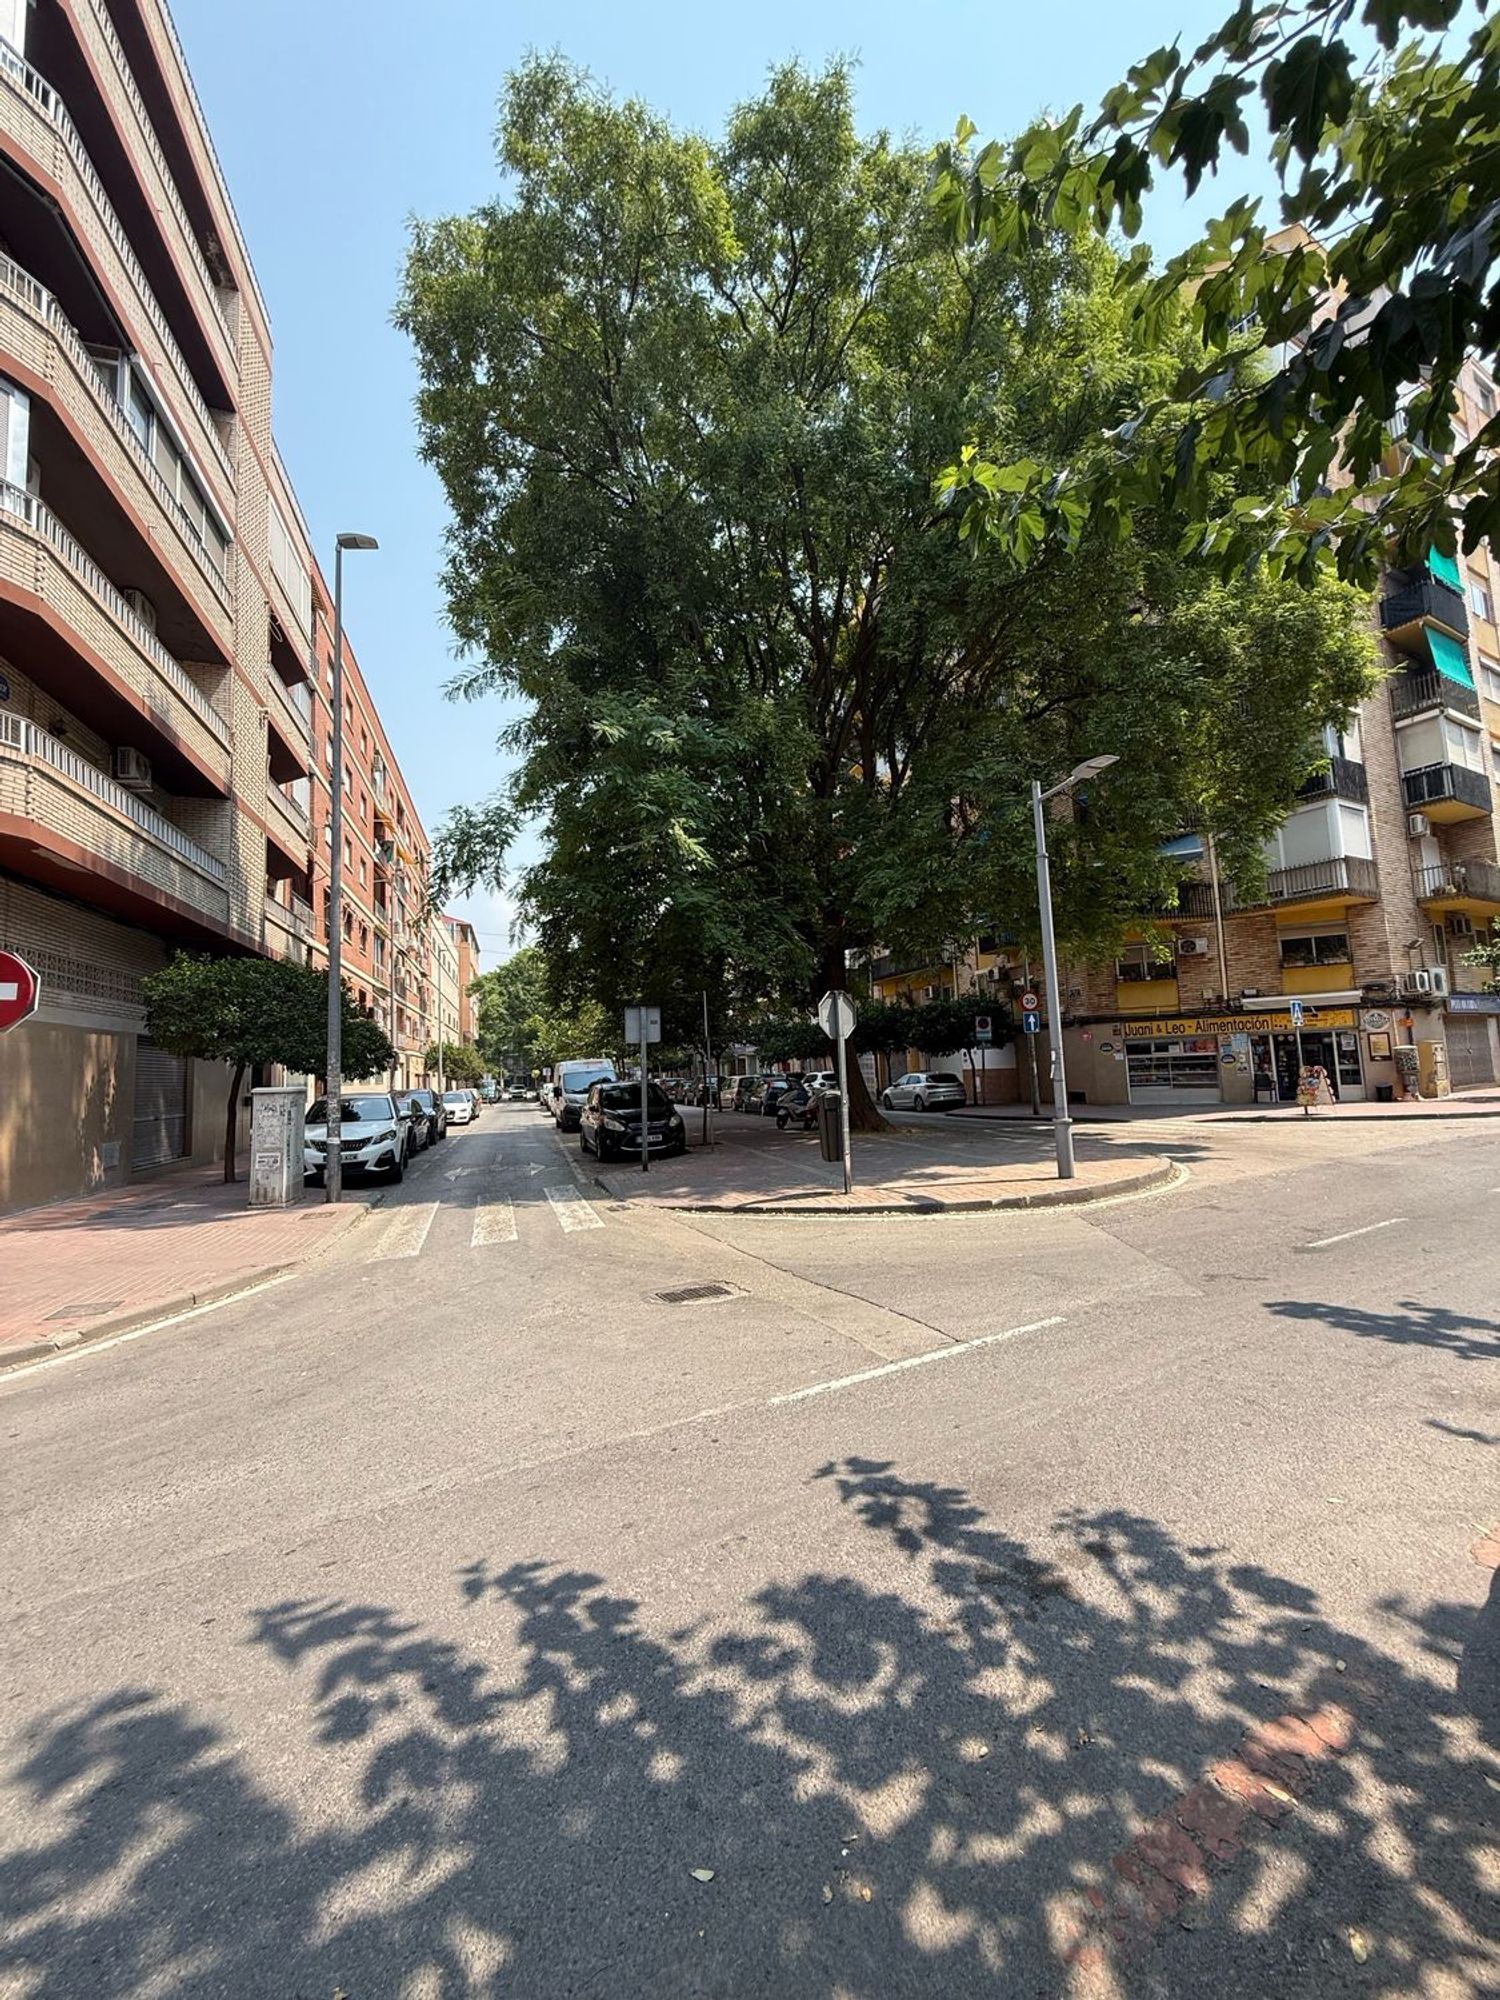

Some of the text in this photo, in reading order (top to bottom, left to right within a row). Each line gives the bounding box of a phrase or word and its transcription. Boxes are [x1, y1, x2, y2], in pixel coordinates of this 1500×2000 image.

[1024, 997, 1036, 1005] 30
[1125, 1022, 1153, 1036] Juani
[1165, 1021, 1185, 1035] Leo
[1195, 1016, 1270, 1033] Alimentación
